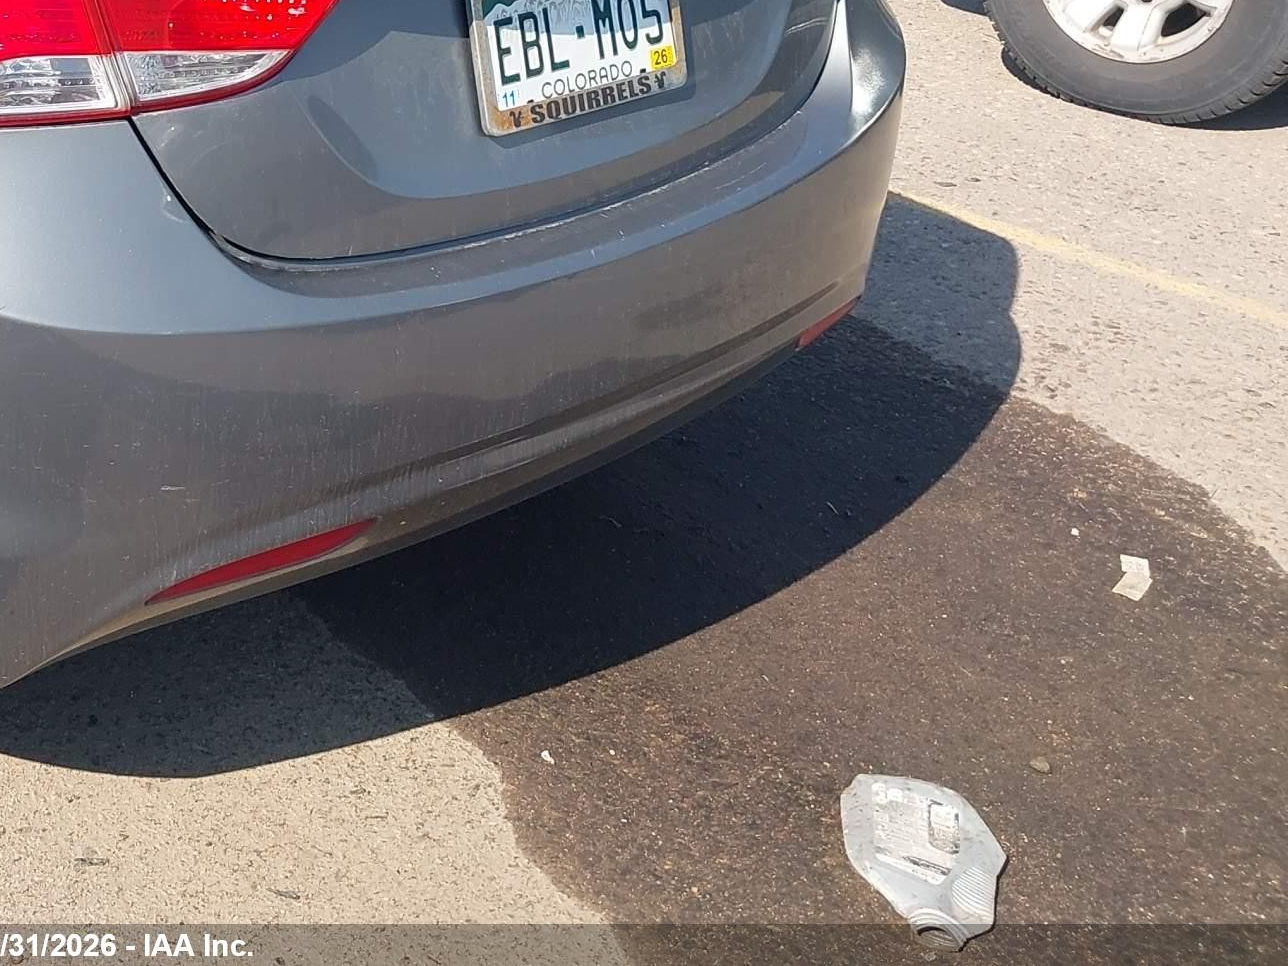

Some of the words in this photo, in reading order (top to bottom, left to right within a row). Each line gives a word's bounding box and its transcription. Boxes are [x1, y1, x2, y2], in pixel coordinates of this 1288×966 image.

[653, 47, 669, 66] 26
[541, 60, 633, 98] COLORADO
[502, 89, 516, 107] 11
[530, 75, 652, 124] SQUIRRELS
